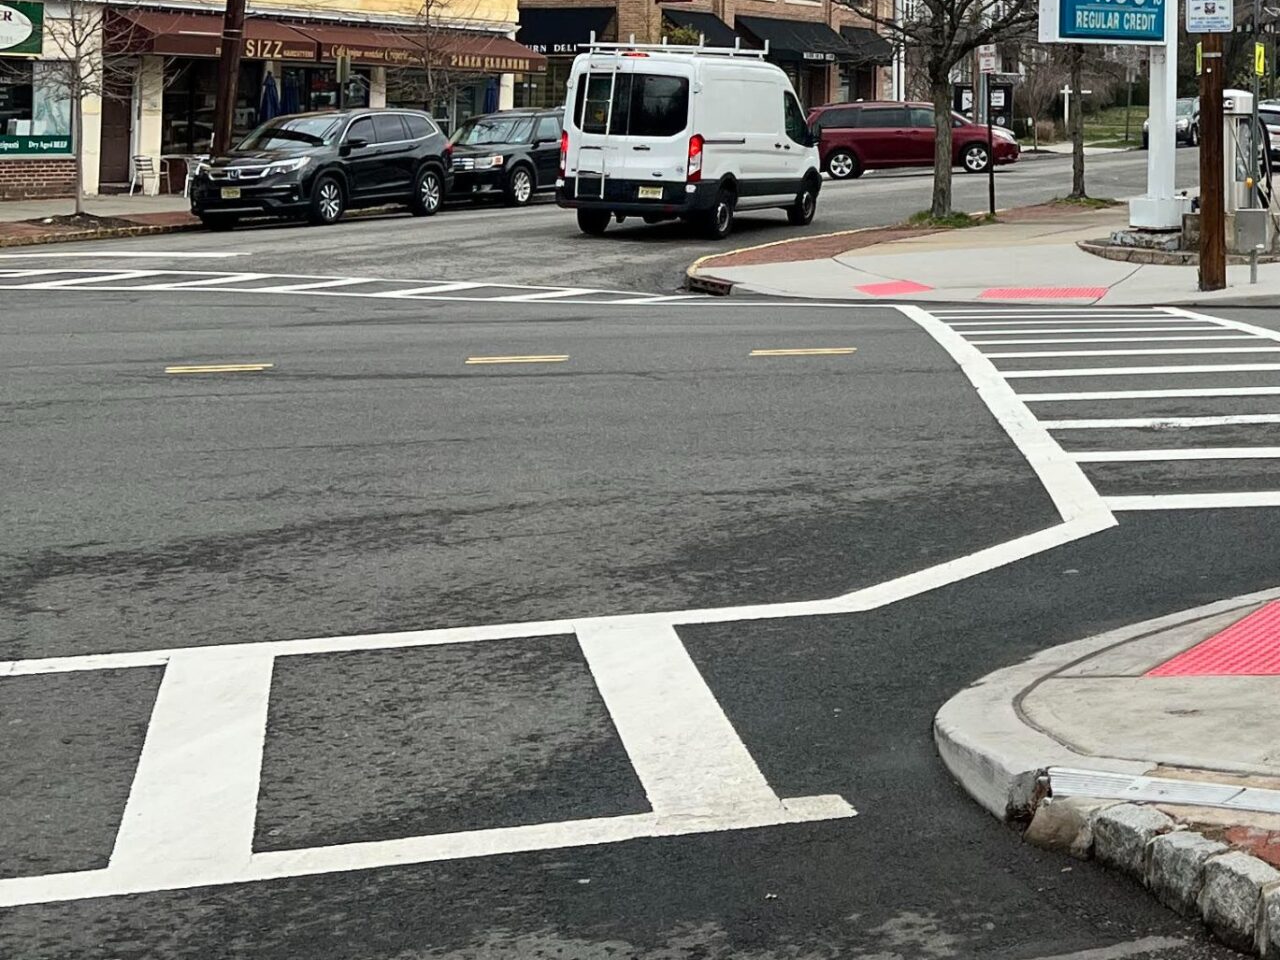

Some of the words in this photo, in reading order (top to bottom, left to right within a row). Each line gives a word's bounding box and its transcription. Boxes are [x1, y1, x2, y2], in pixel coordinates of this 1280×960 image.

[1076, 11, 1120, 30] REGULAR
[1123, 12, 1156, 31] CREDIT
[245, 39, 283, 58] SIZZ
[553, 43, 577, 53] DELI
[451, 54, 482, 68] PLAZA
